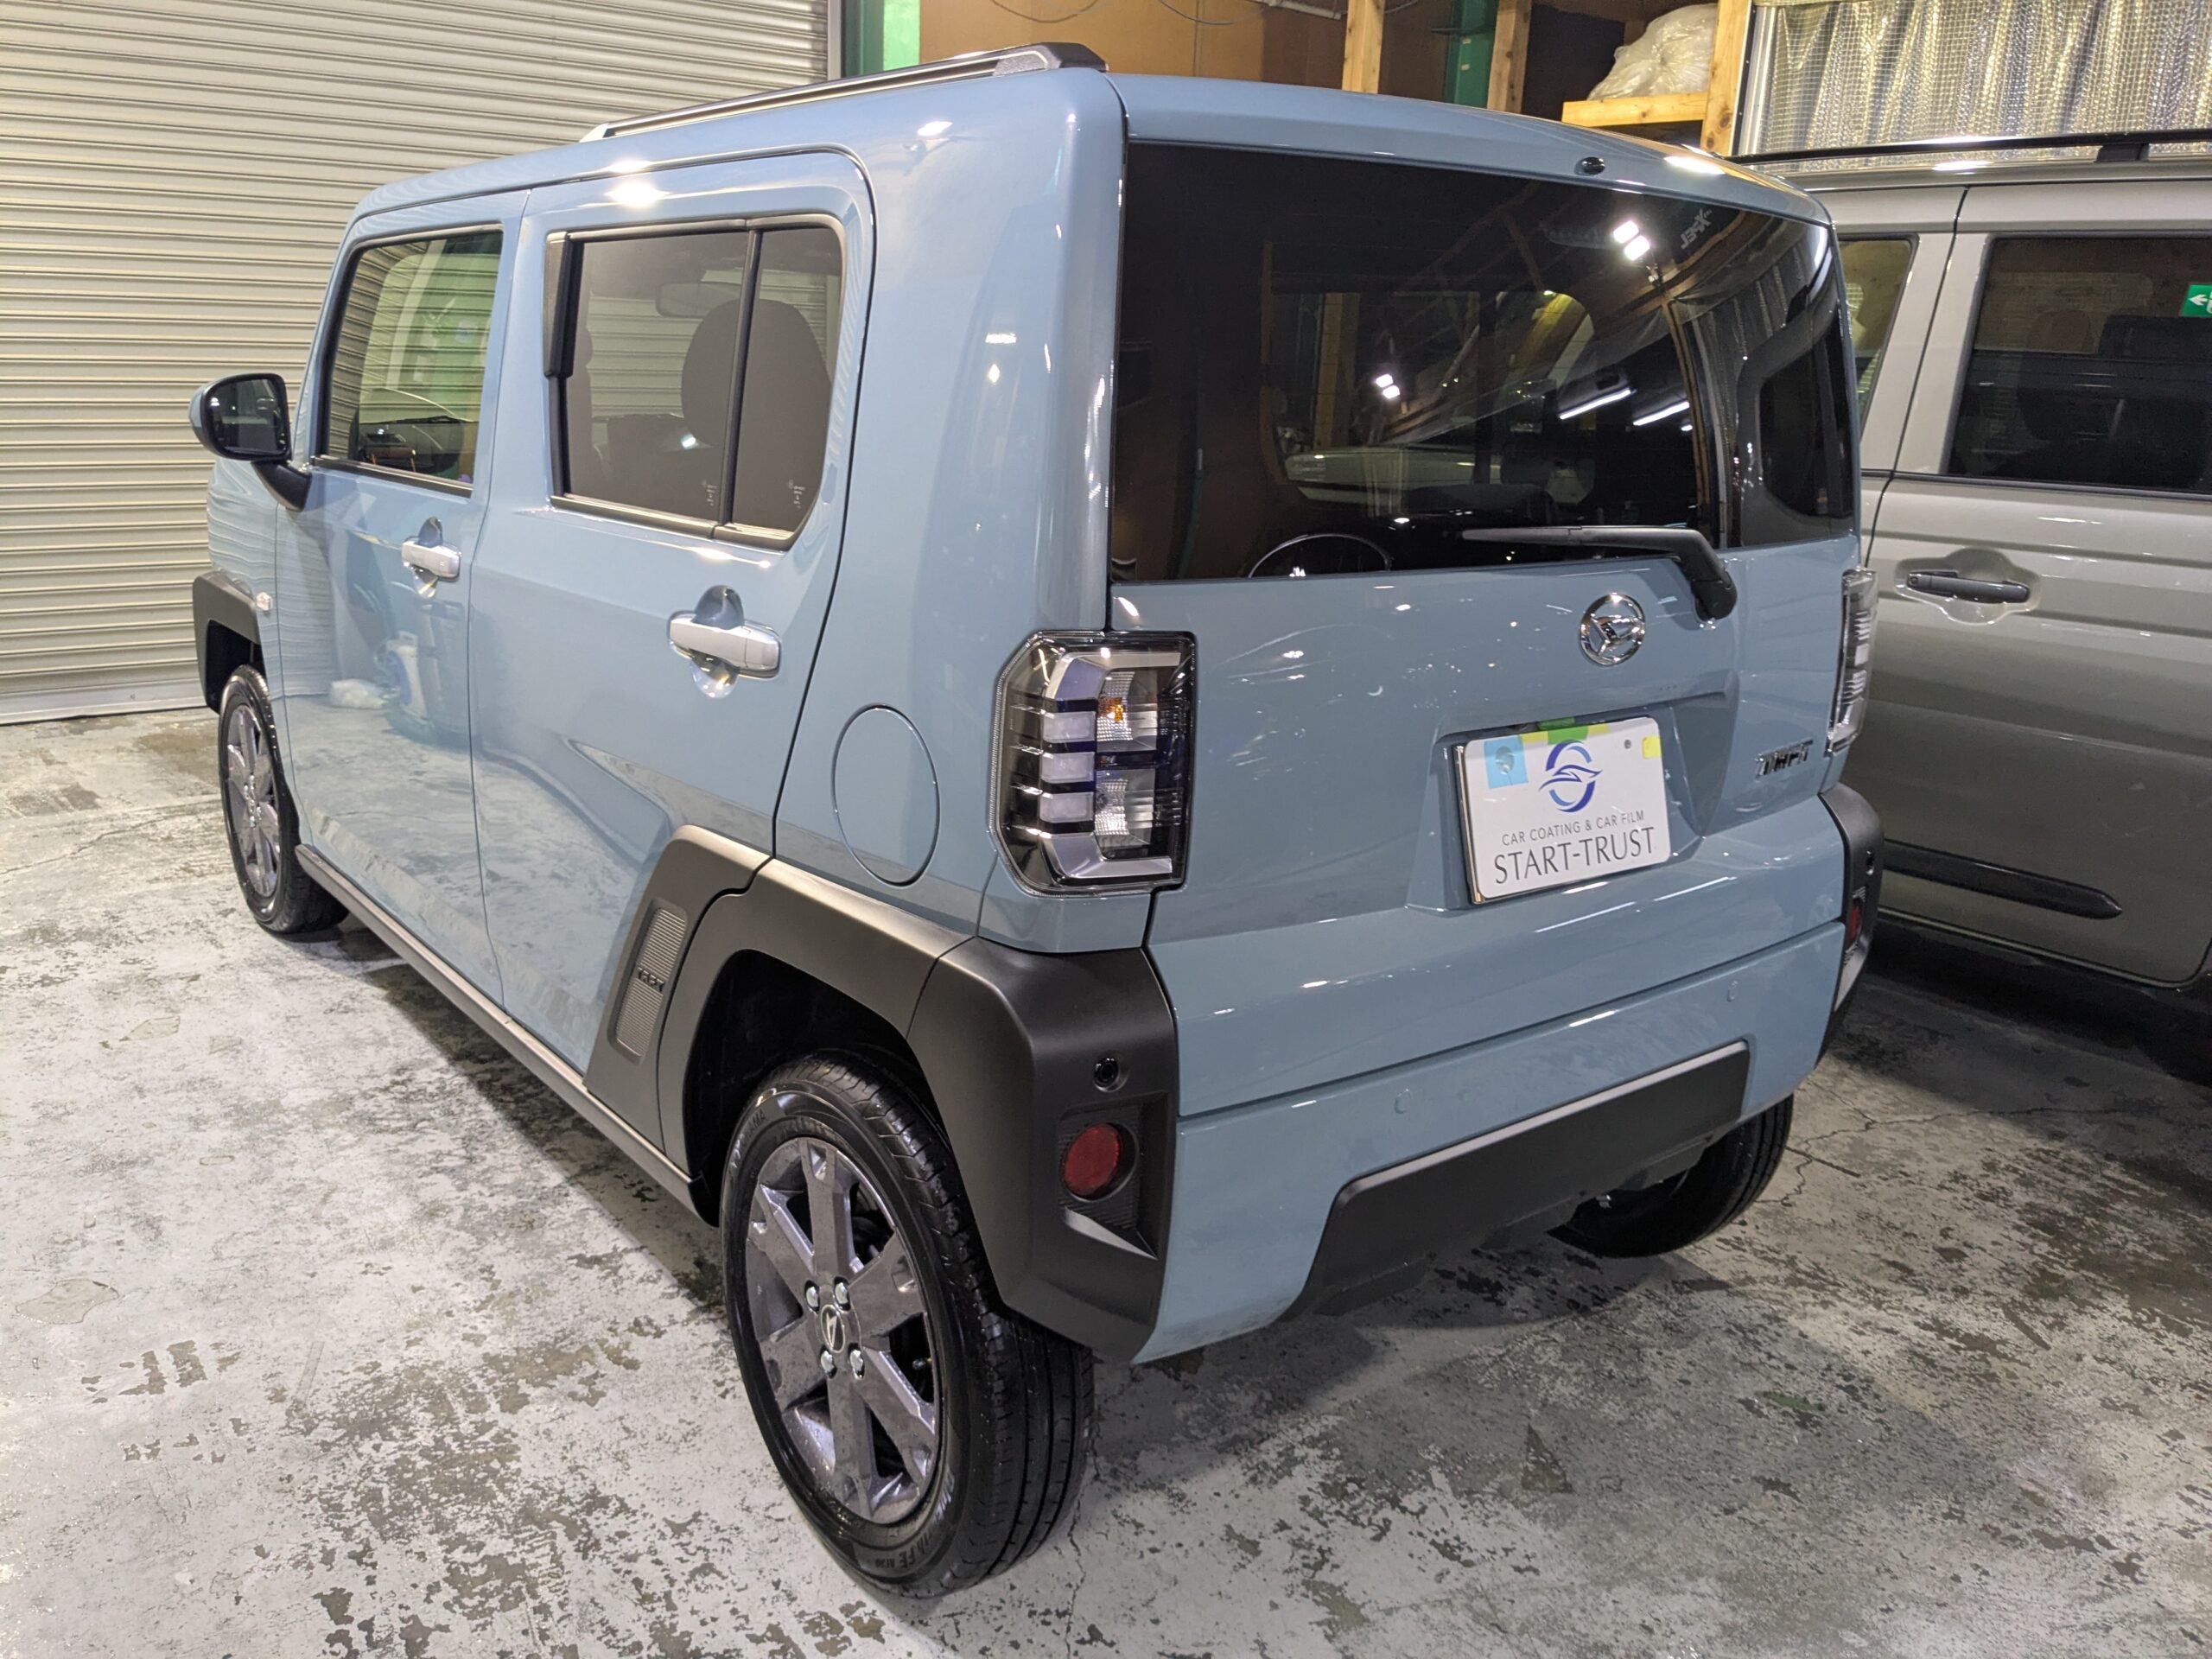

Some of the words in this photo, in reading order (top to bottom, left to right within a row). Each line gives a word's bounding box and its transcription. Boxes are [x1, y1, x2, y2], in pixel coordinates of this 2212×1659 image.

[1502, 830, 1525, 846] CAR
[1529, 822, 1580, 841] COATING
[1585, 820, 1592, 830] &
[1596, 815, 1617, 830] CAR
[1621, 810, 1644, 824] FILM
[1494, 827, 1655, 885] START-TRUST
